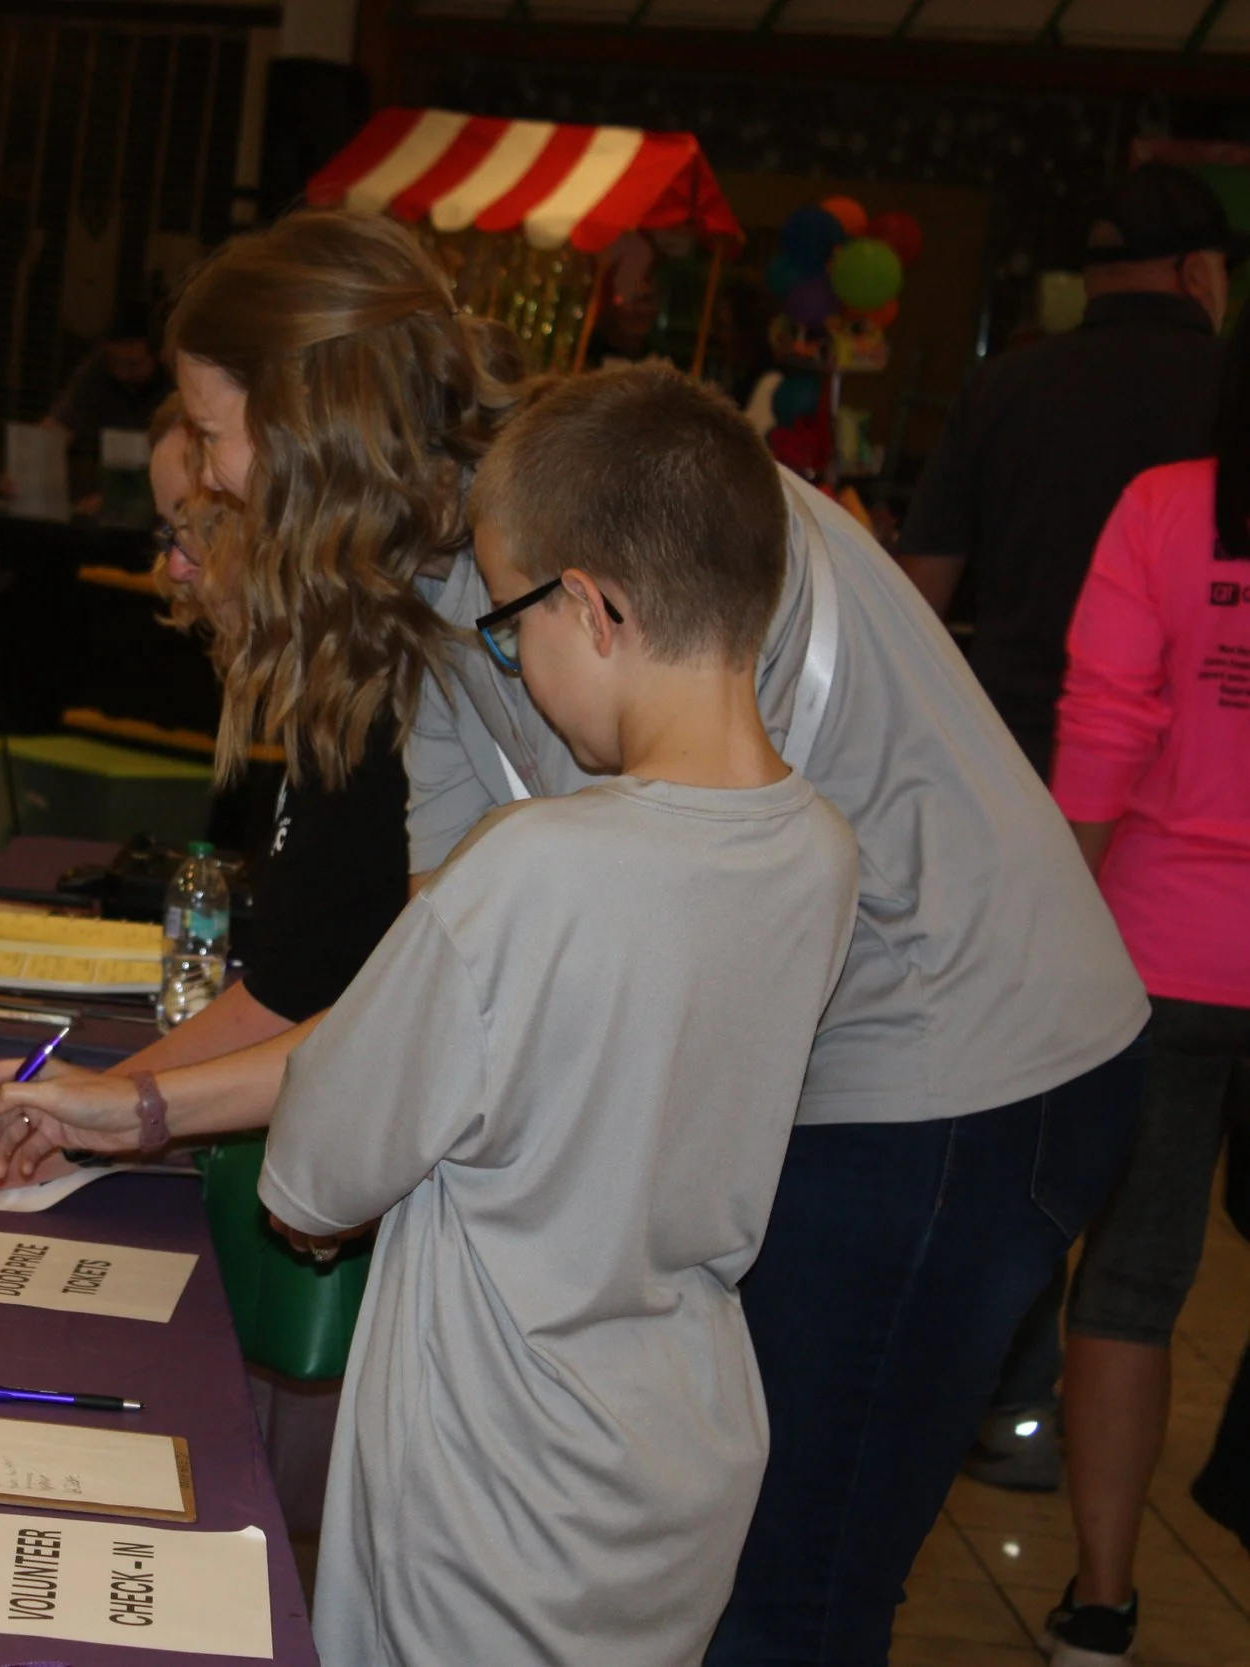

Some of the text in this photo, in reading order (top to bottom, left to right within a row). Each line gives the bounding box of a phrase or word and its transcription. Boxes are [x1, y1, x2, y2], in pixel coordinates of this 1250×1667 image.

[4, 1243, 50, 1269] PRIZE
[62, 1259, 111, 1295] TICKETS
[8, 1529, 61, 1619] VOLUNTEER
